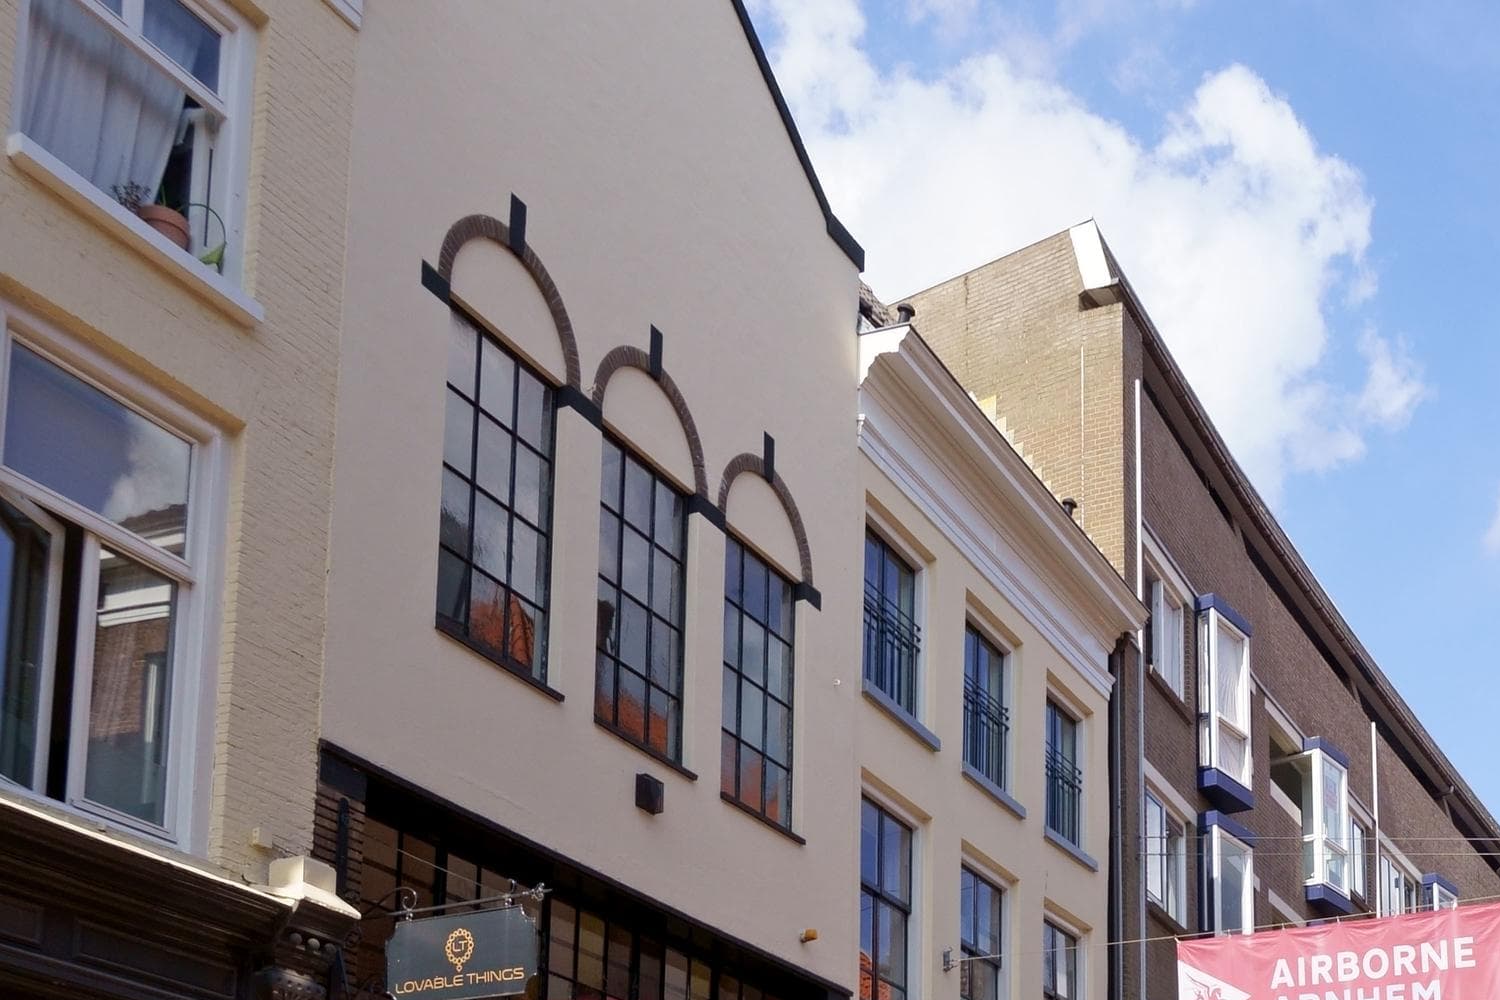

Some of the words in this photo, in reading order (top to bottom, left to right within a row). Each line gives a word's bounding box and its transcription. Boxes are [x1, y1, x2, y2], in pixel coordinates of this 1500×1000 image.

[452, 940, 468, 952] LT
[1270, 935, 1477, 989] AIRBORNE
[395, 974, 464, 994] LOVABLE
[466, 967, 525, 985] THINGS
